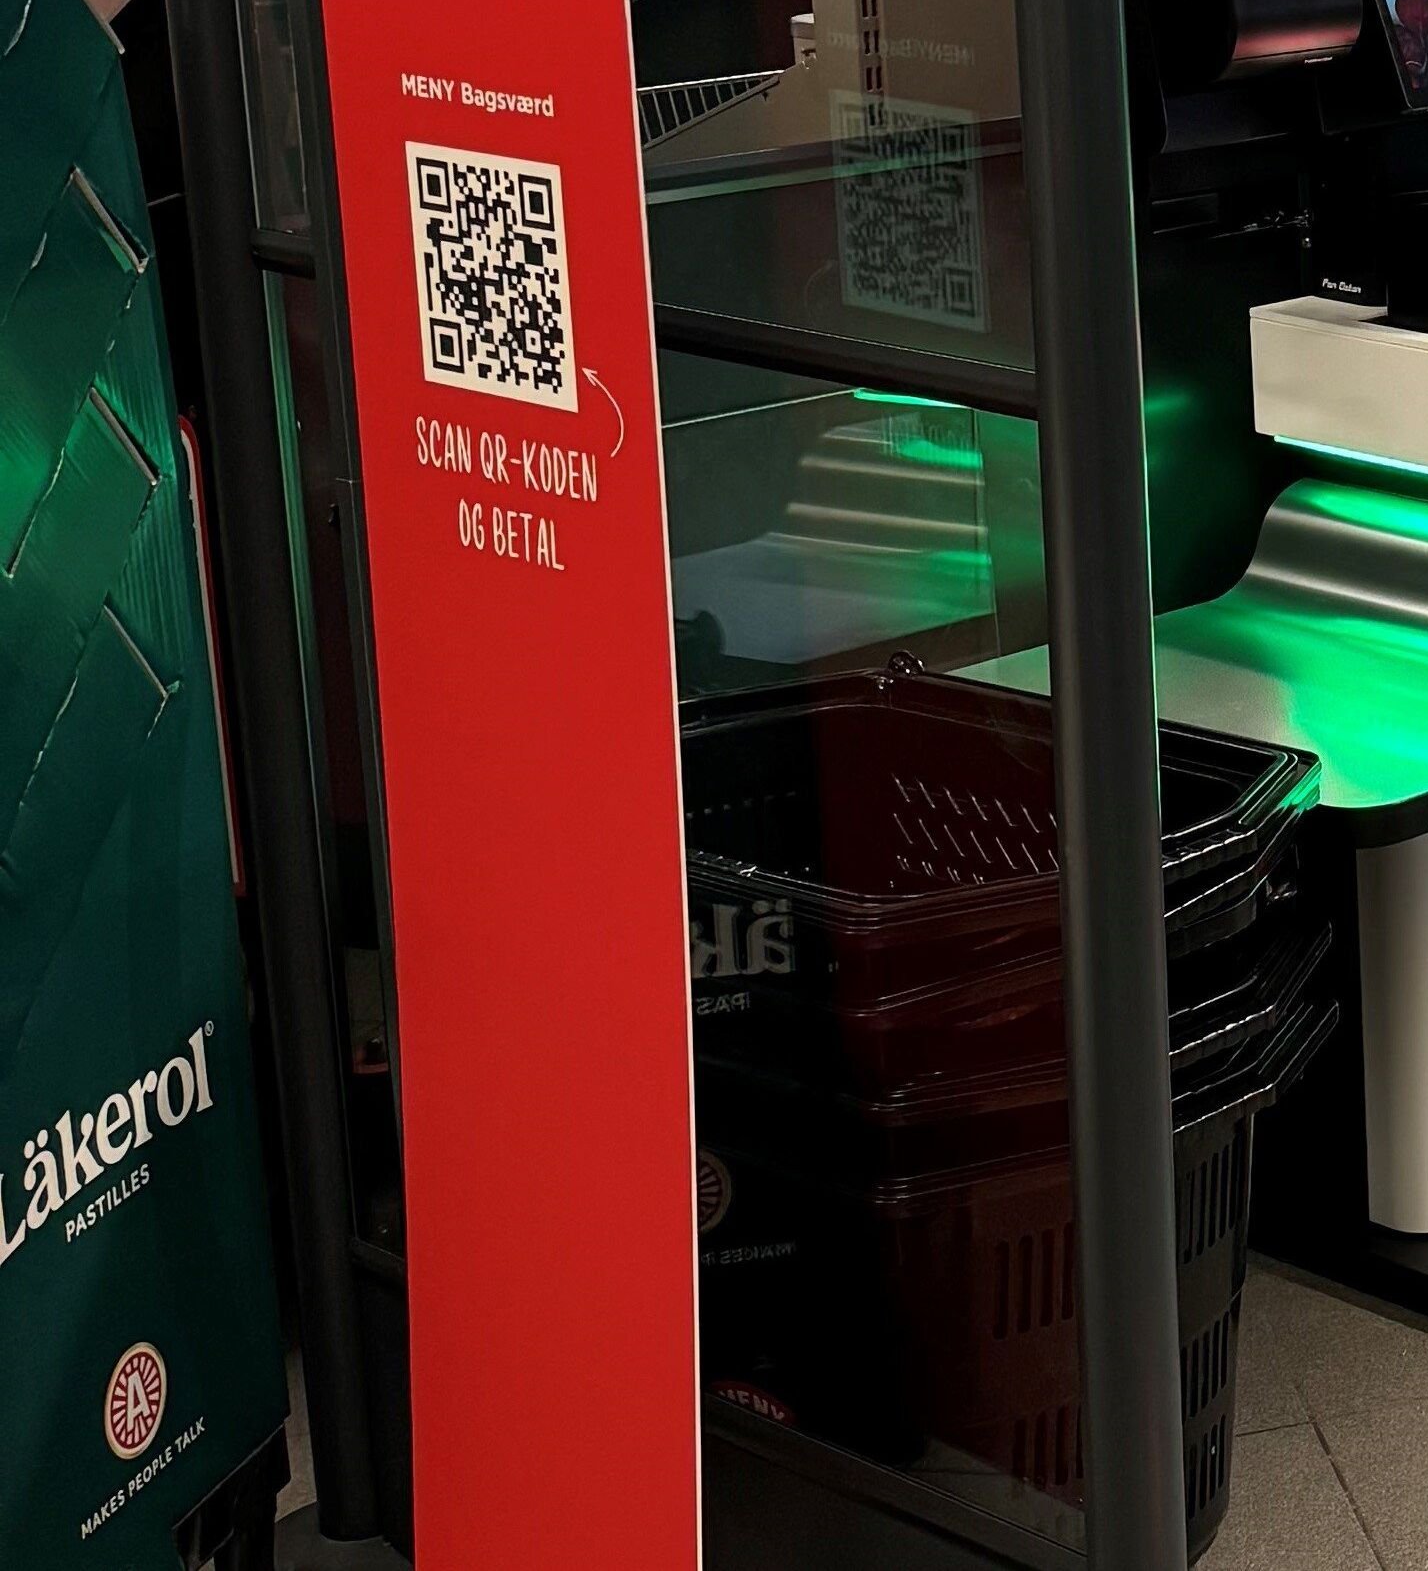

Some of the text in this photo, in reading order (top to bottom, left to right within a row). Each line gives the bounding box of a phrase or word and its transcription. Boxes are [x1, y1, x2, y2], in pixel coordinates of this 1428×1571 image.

[401, 72, 555, 118] MENY Bagsværd
[416, 416, 597, 502] SCAN QR-KODEN
[459, 498, 565, 571] OG BETAL
[0, 1025, 214, 1267] Läkerol
[65, 1163, 151, 1243] PASTILLES
[81, 1416, 206, 1540] MAKES PEOPLE TALK
